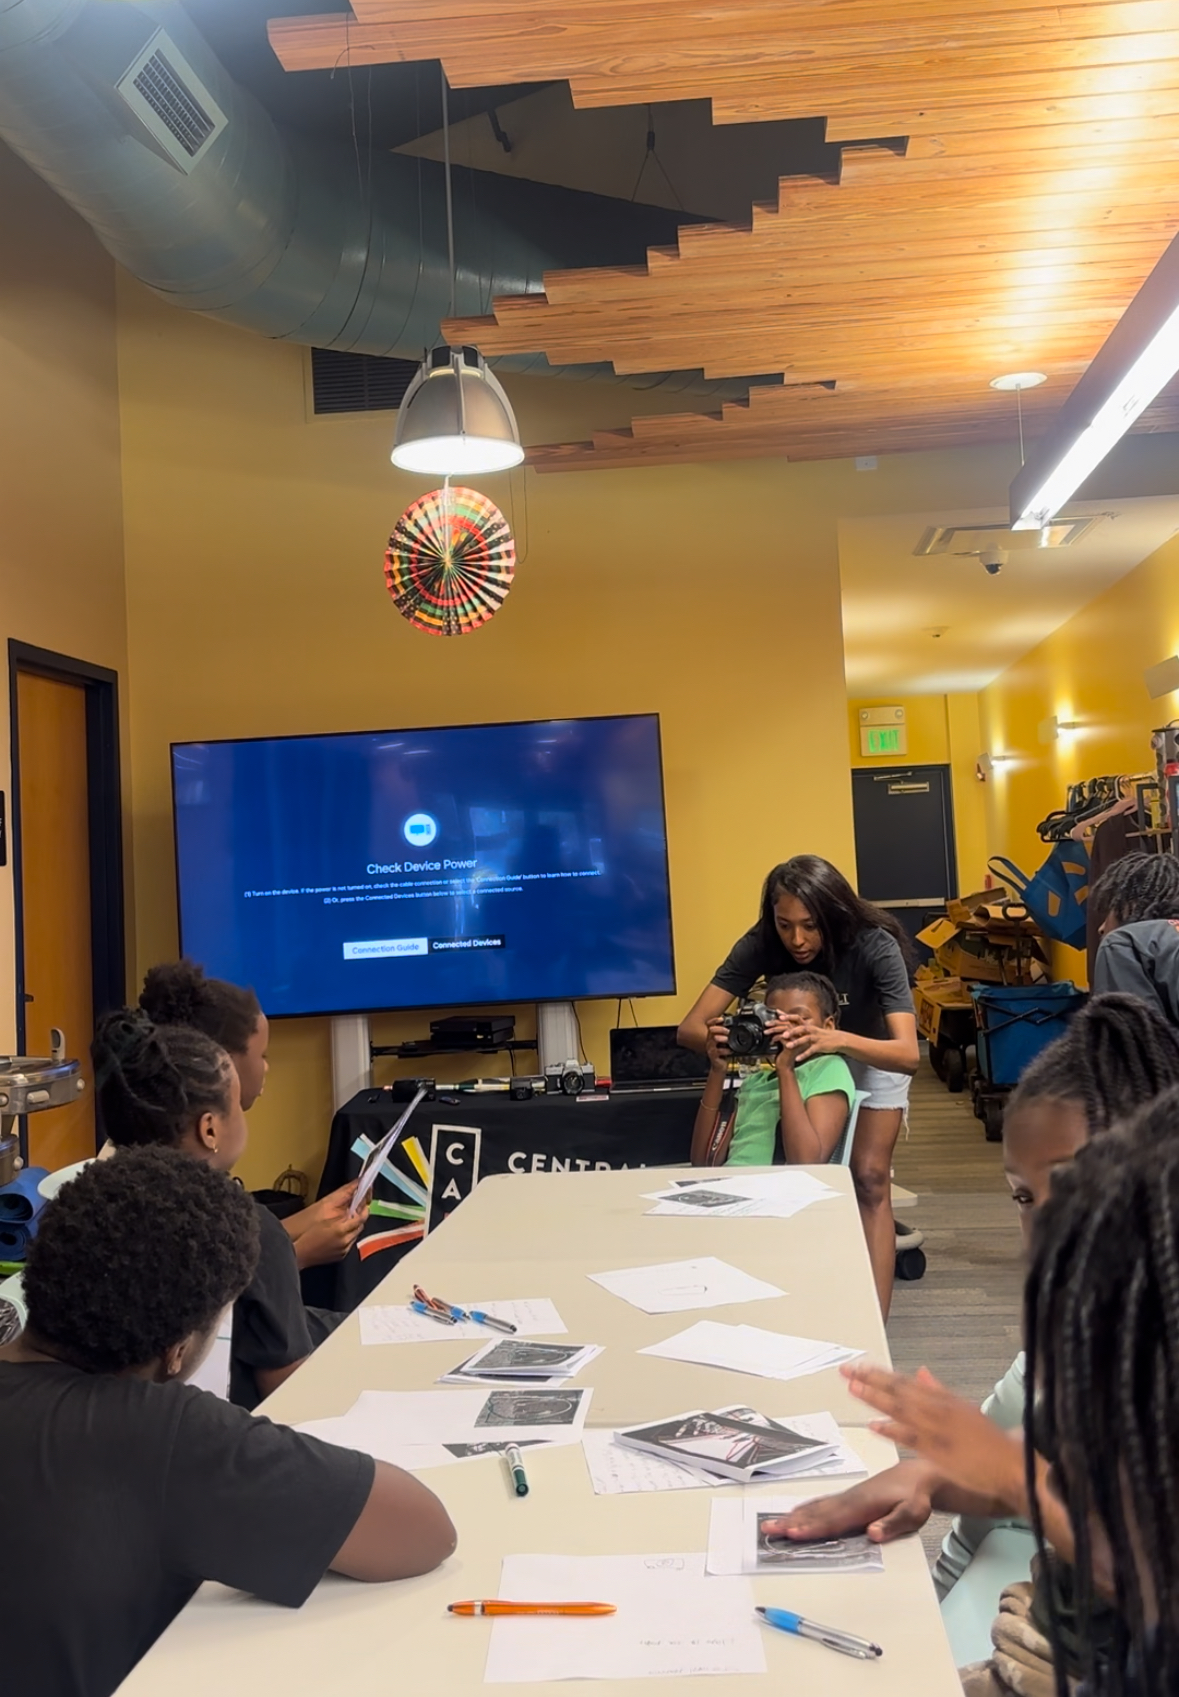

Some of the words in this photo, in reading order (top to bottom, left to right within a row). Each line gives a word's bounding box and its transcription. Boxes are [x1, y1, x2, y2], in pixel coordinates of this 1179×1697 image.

[868, 729, 899, 753] EXIT
[366, 862, 403, 875] Check
[404, 860, 441, 873] Device
[443, 858, 478, 871] Power
[351, 944, 396, 955] Connection
[396, 943, 420, 952] Guide
[432, 939, 472, 950] Connected
[473, 937, 502, 948] Devices
[712, 1120, 727, 1151] Canon
